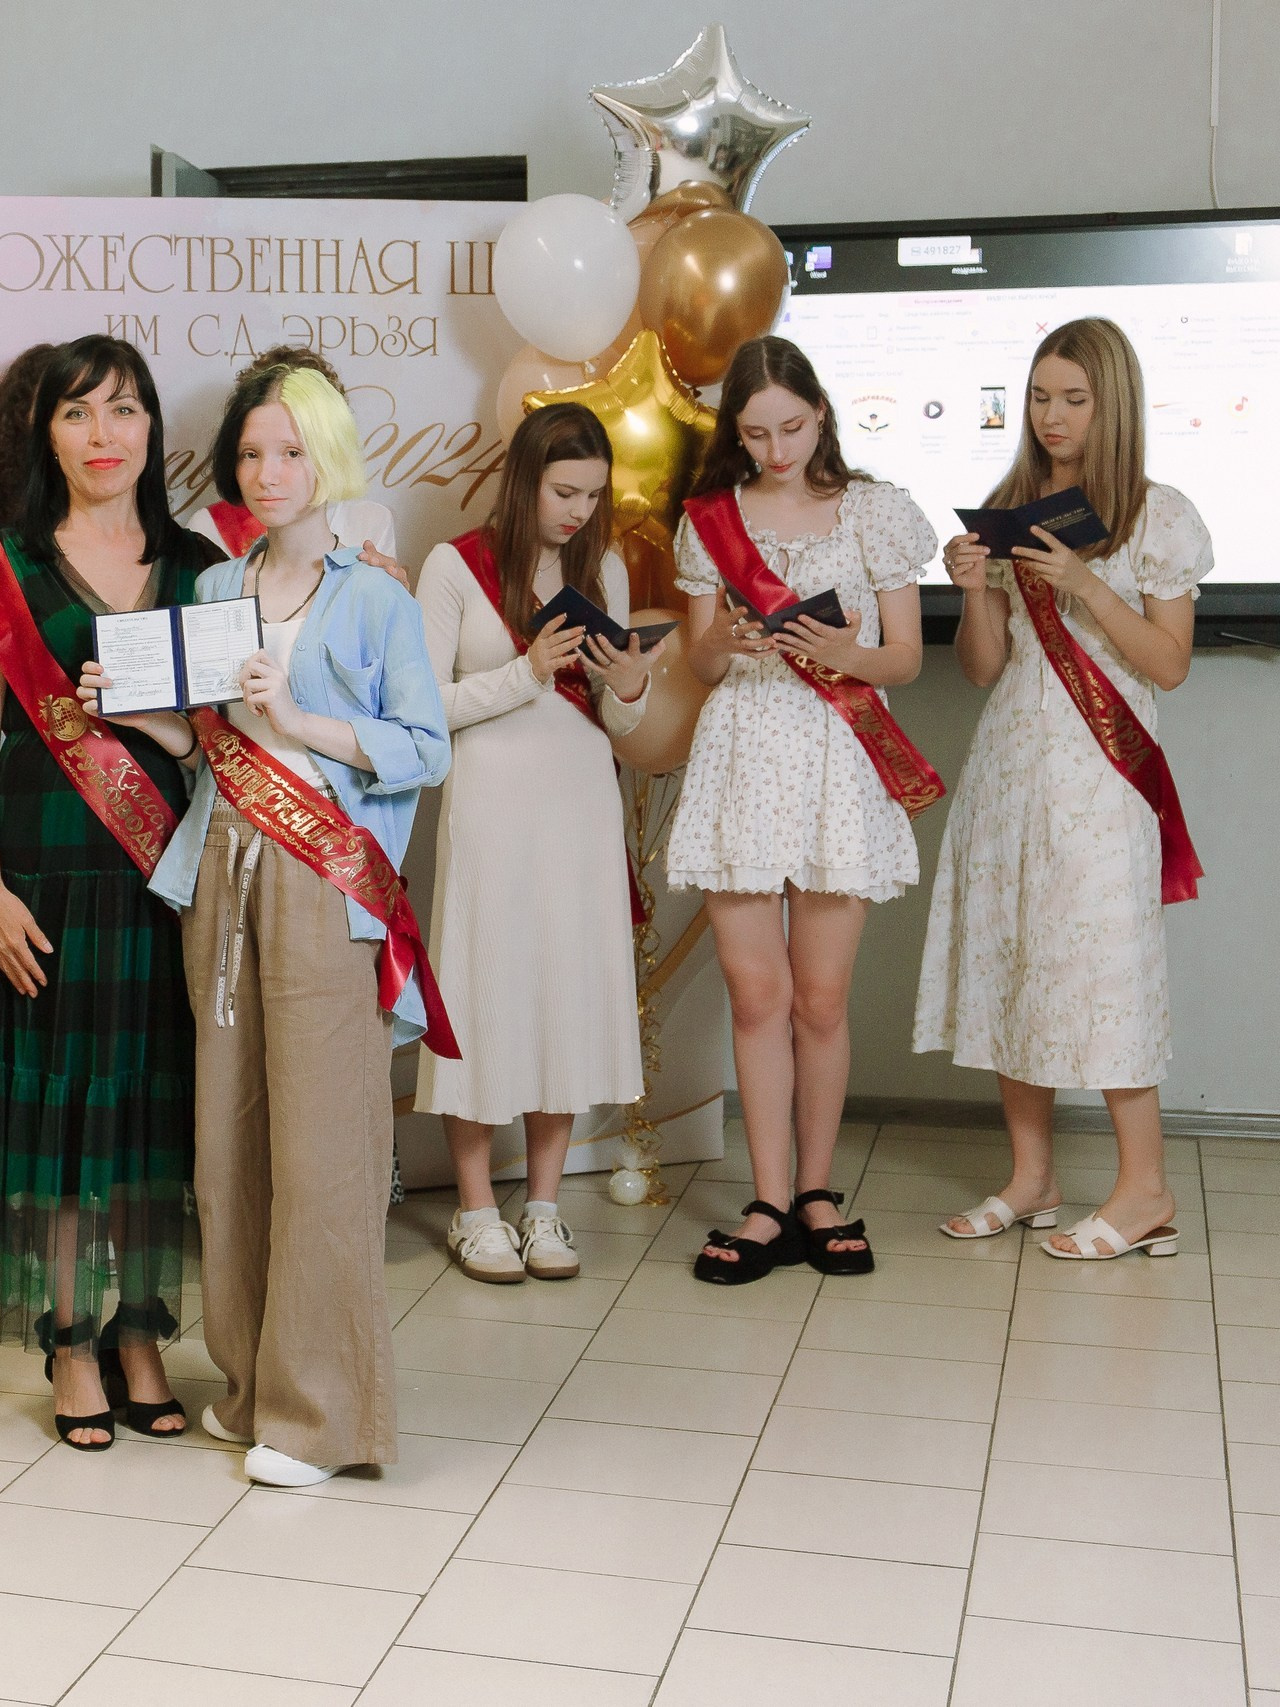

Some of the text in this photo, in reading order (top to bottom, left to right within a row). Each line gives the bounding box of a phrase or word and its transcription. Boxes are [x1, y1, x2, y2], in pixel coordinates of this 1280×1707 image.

[446, 240, 497, 295] Ш
[923, 245, 961, 256] 491827
[104, 313, 161, 356] ИМ
[282, 313, 440, 357] ЭРЬЗЯ
[363, 421, 507, 511] 2024
[207, 729, 344, 858] Выпускник
